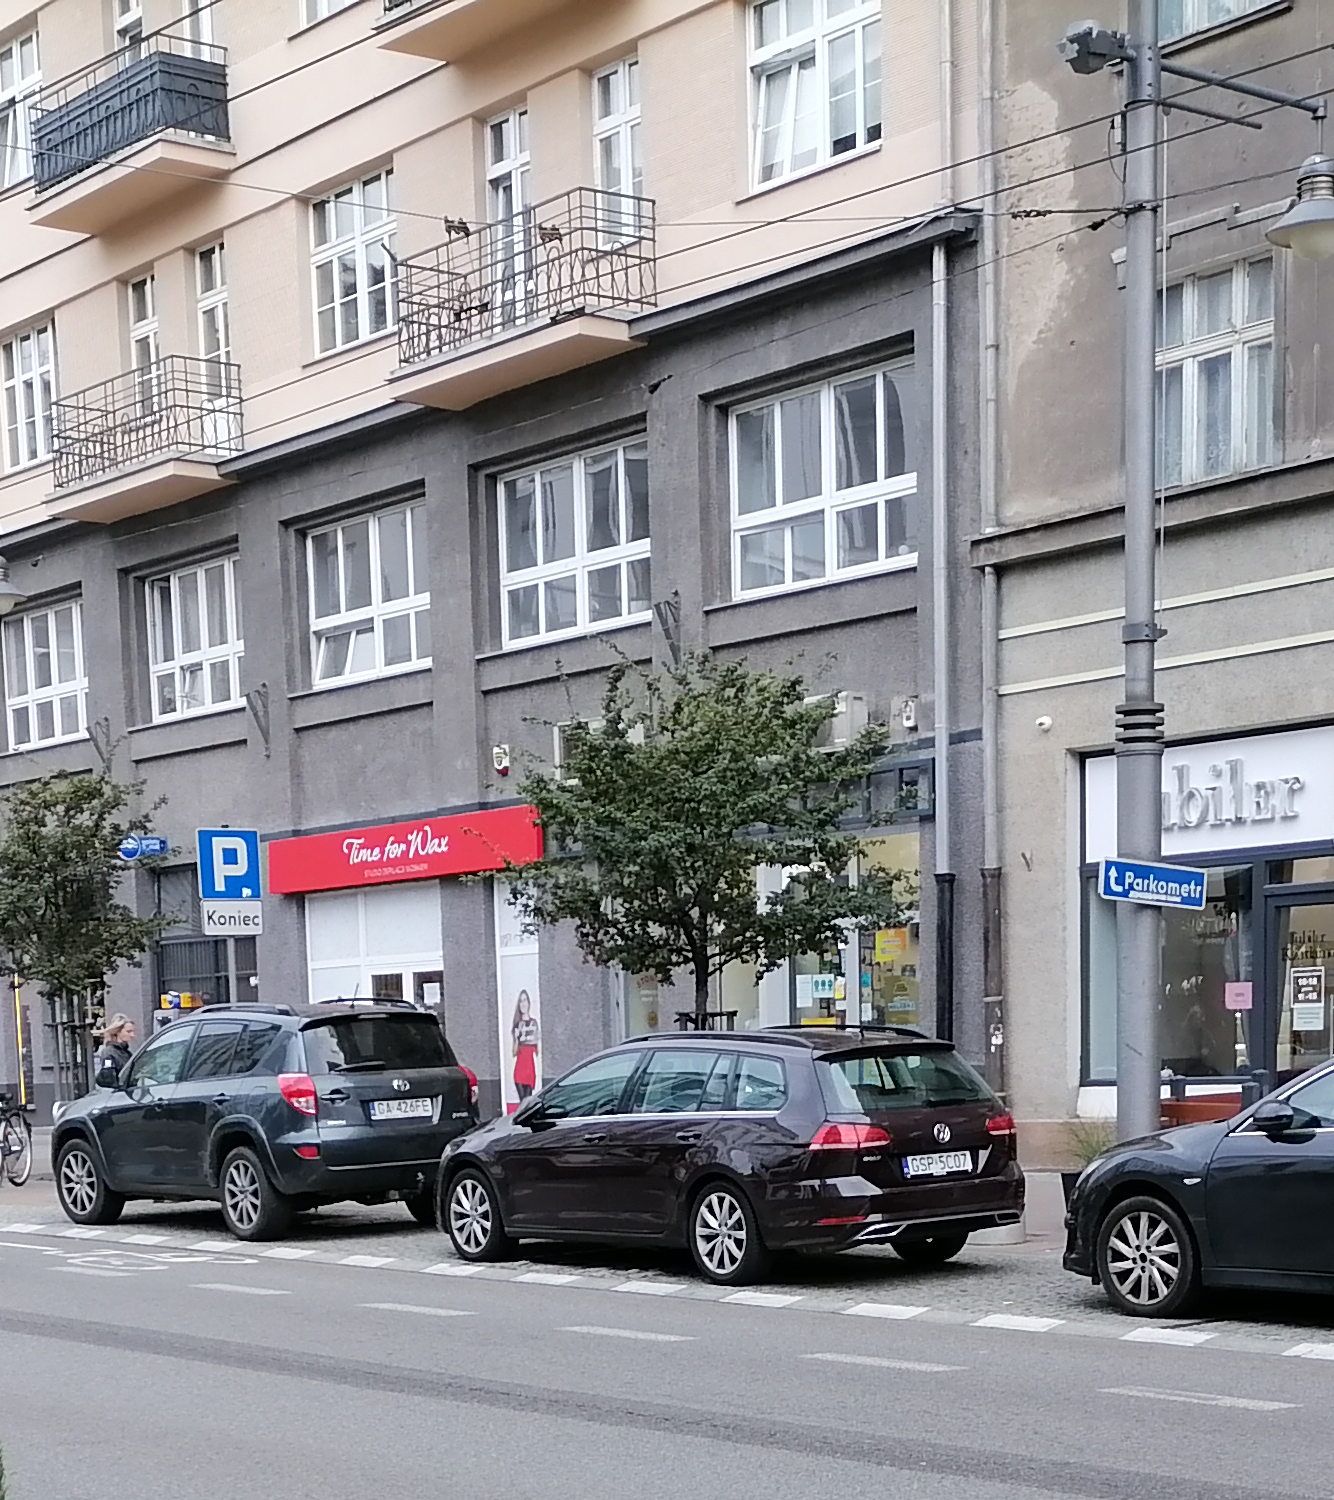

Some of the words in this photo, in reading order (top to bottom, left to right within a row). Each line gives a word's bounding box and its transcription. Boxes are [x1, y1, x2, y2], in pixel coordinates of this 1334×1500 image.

[343, 837, 382, 865] Time
[383, 836, 407, 862] for
[407, 825, 449, 858] Wax
[212, 836, 248, 891] P
[1124, 871, 1202, 899] Parkometr
[206, 909, 260, 926] Koniec
[376, 1102, 393, 1115] GA
[911, 1156, 934, 1173] GSP
[939, 1153, 967, 1170] 5C07
